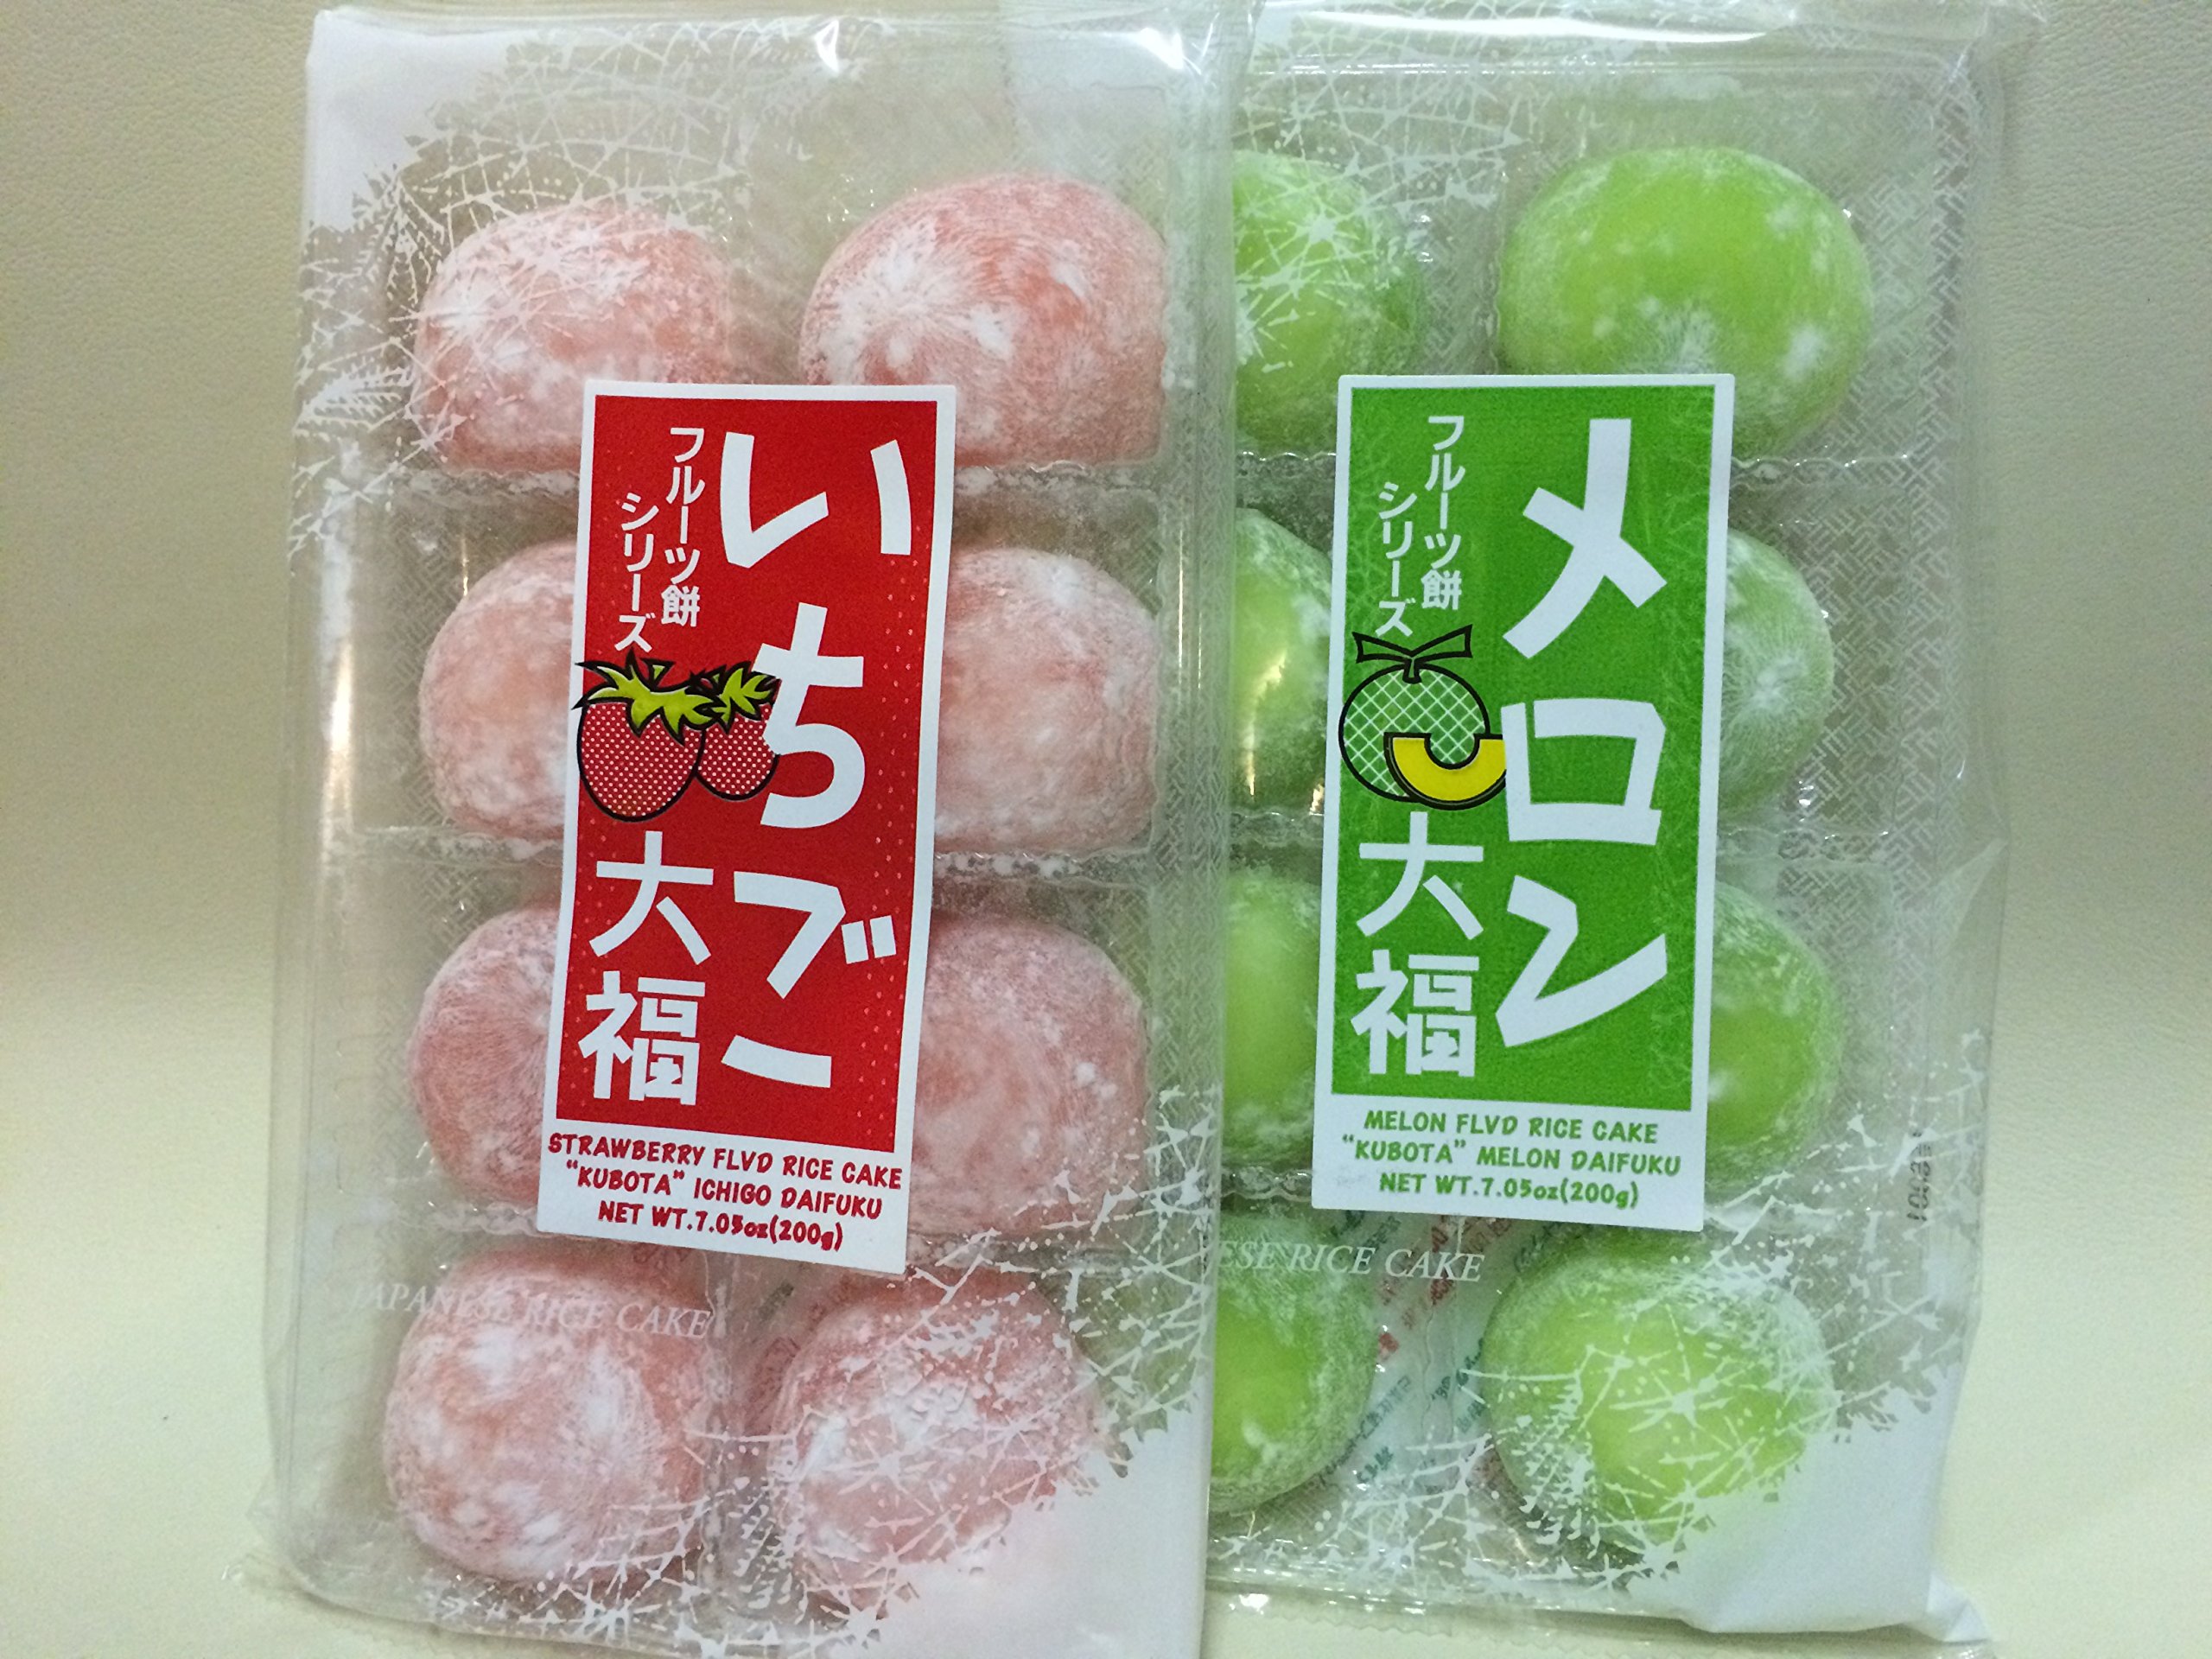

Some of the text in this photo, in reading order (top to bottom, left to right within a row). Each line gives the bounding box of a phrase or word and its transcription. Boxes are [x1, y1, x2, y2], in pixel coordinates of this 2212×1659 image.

[660, 427, 706, 628] フルーツ餅
[1375, 481, 1418, 638] シリーズ
[1421, 415, 1466, 611] フルーツ餅
[613, 492, 659, 653] シリーズ
[719, 430, 912, 1090] いちご
[1494, 417, 1669, 1048] メロン
[577, 830, 715, 1107] 大福
[1350, 810, 1484, 1078] 大福
[547, 1132, 903, 1191] STRAWBERRY FLVD RICE CAKE
[1363, 1109, 1659, 1145] MELON FLVD RICE CAKE
[1476, 1146, 1560, 1170] MELON
[1570, 1149, 1681, 1177] DAIFUKU
[597, 1200, 645, 1225] NET
[693, 1177, 772, 1208] ICHIGO
[779, 1186, 884, 1221] DAIFUKU
[1379, 1172, 1426, 1194] NET
[519, 1292, 604, 1331] RICE
[616, 1303, 714, 1339] CAKE
[1287, 1242, 1376, 1275] RICE
[1384, 1249, 1485, 1283] CAKE
